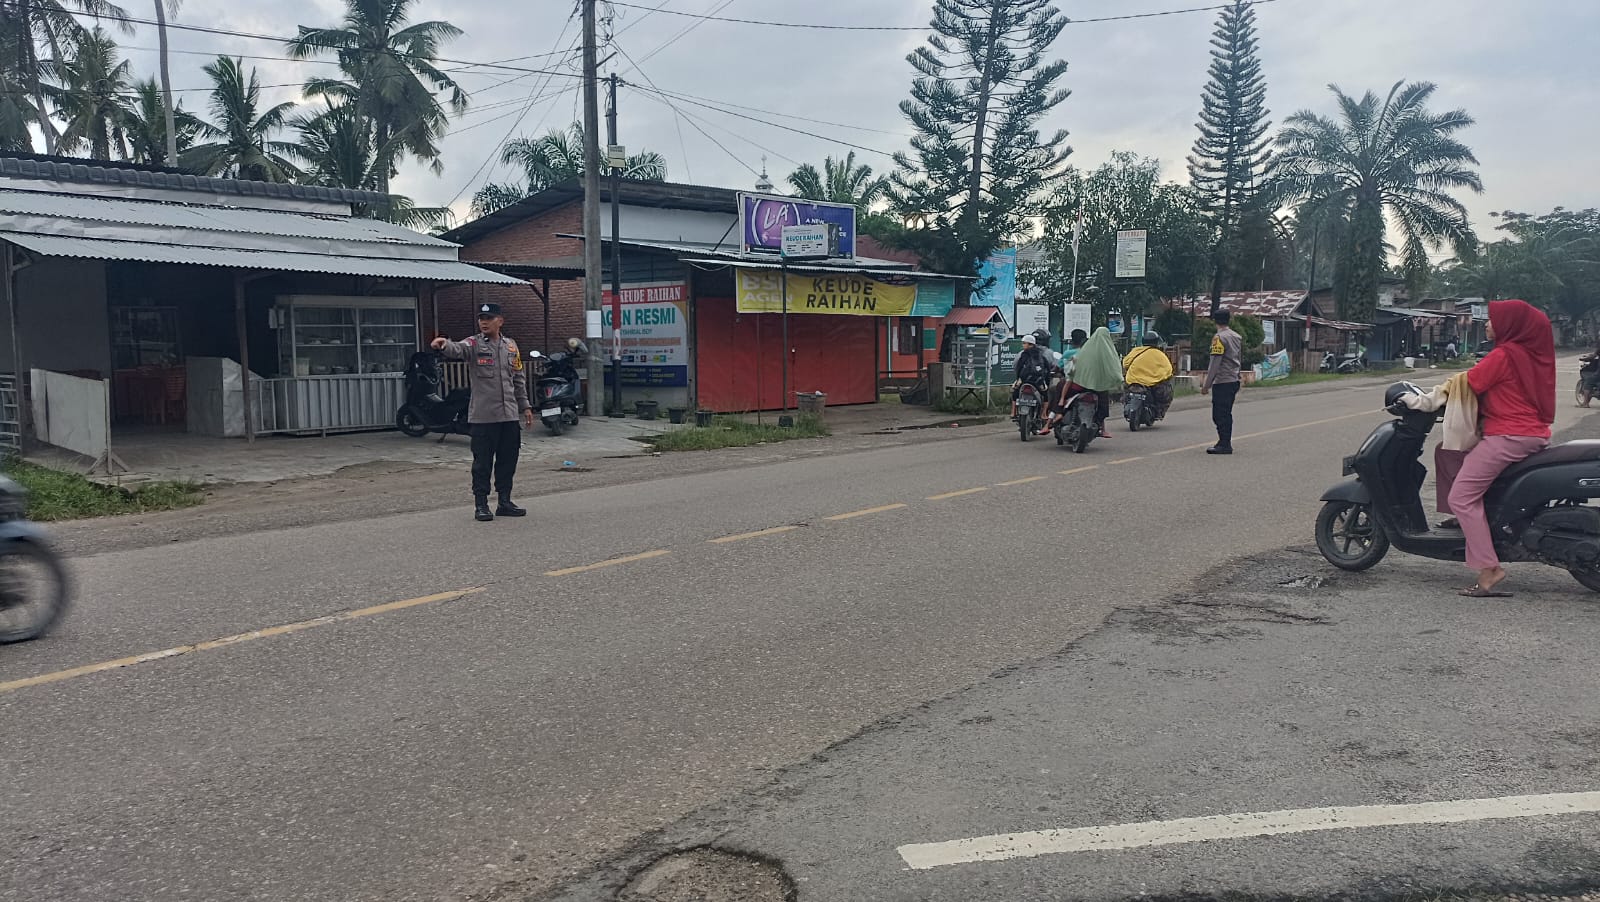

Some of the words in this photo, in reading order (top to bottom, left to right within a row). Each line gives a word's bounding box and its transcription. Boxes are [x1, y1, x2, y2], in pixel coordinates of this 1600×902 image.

[647, 287, 681, 302] RAIHAN
[813, 278, 874, 296] KEUDE
[744, 292, 792, 302] AGEN
[806, 294, 877, 311] RAIHAN
[635, 307, 676, 325] RESMI
